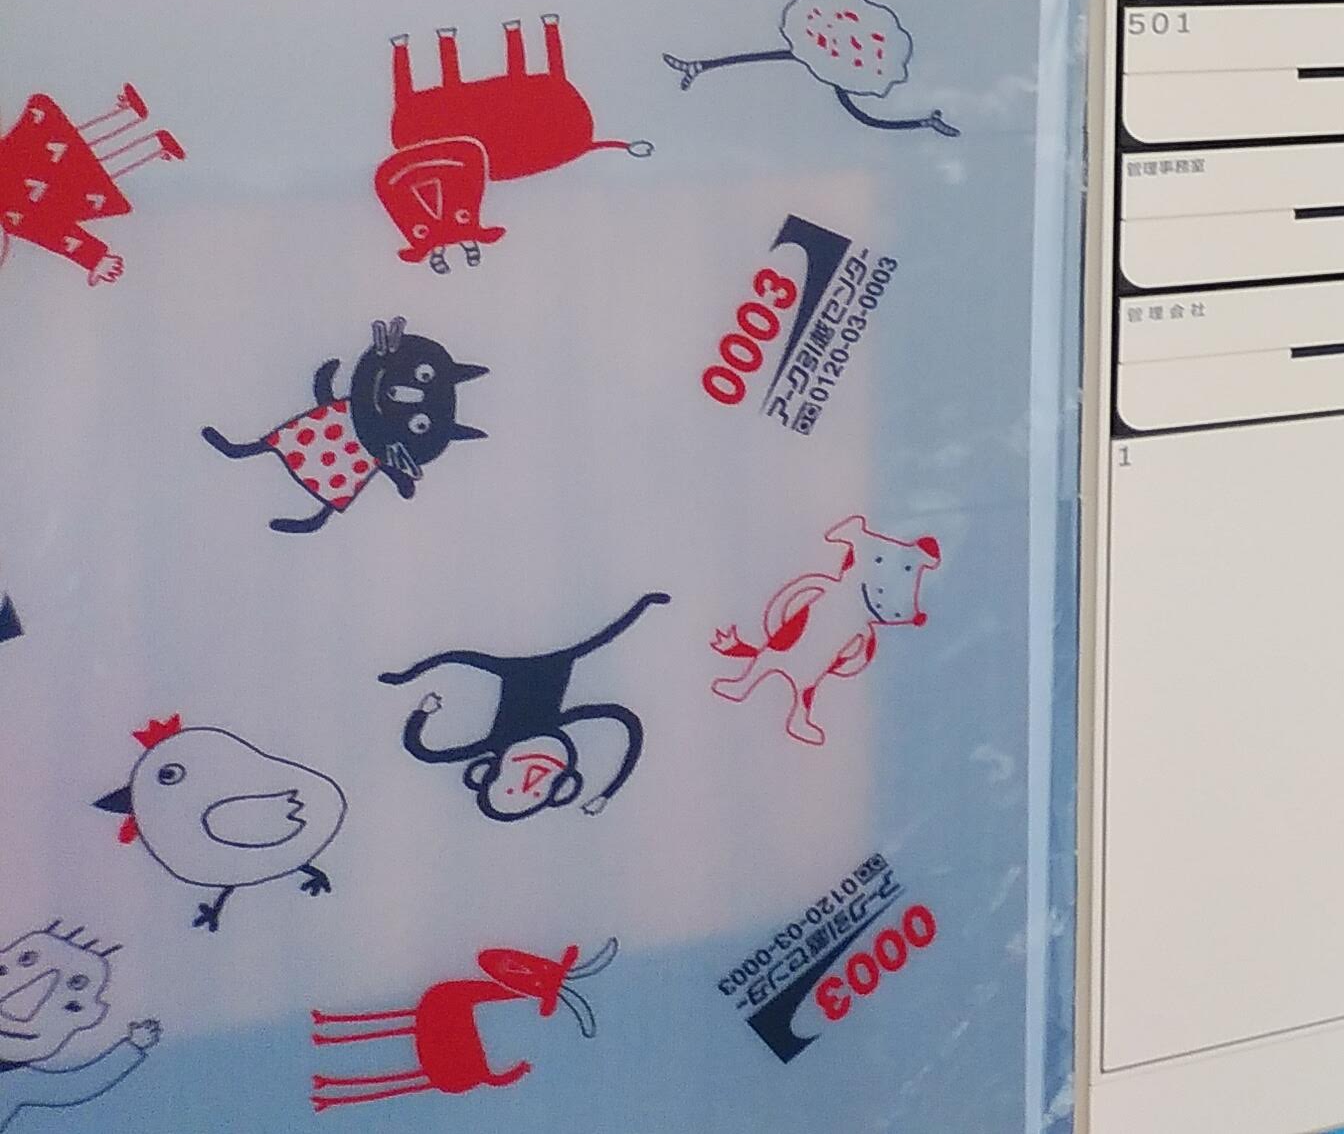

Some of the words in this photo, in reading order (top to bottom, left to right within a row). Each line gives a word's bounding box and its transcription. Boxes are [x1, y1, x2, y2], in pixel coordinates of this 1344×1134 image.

[1128, 13, 1190, 35] 501
[701, 268, 798, 405] 0003
[809, 256, 898, 404] 0120-03-0003
[1119, 447, 1131, 466] 1
[718, 877, 858, 996] 0120-03-0003
[815, 904, 936, 1021] 0003
